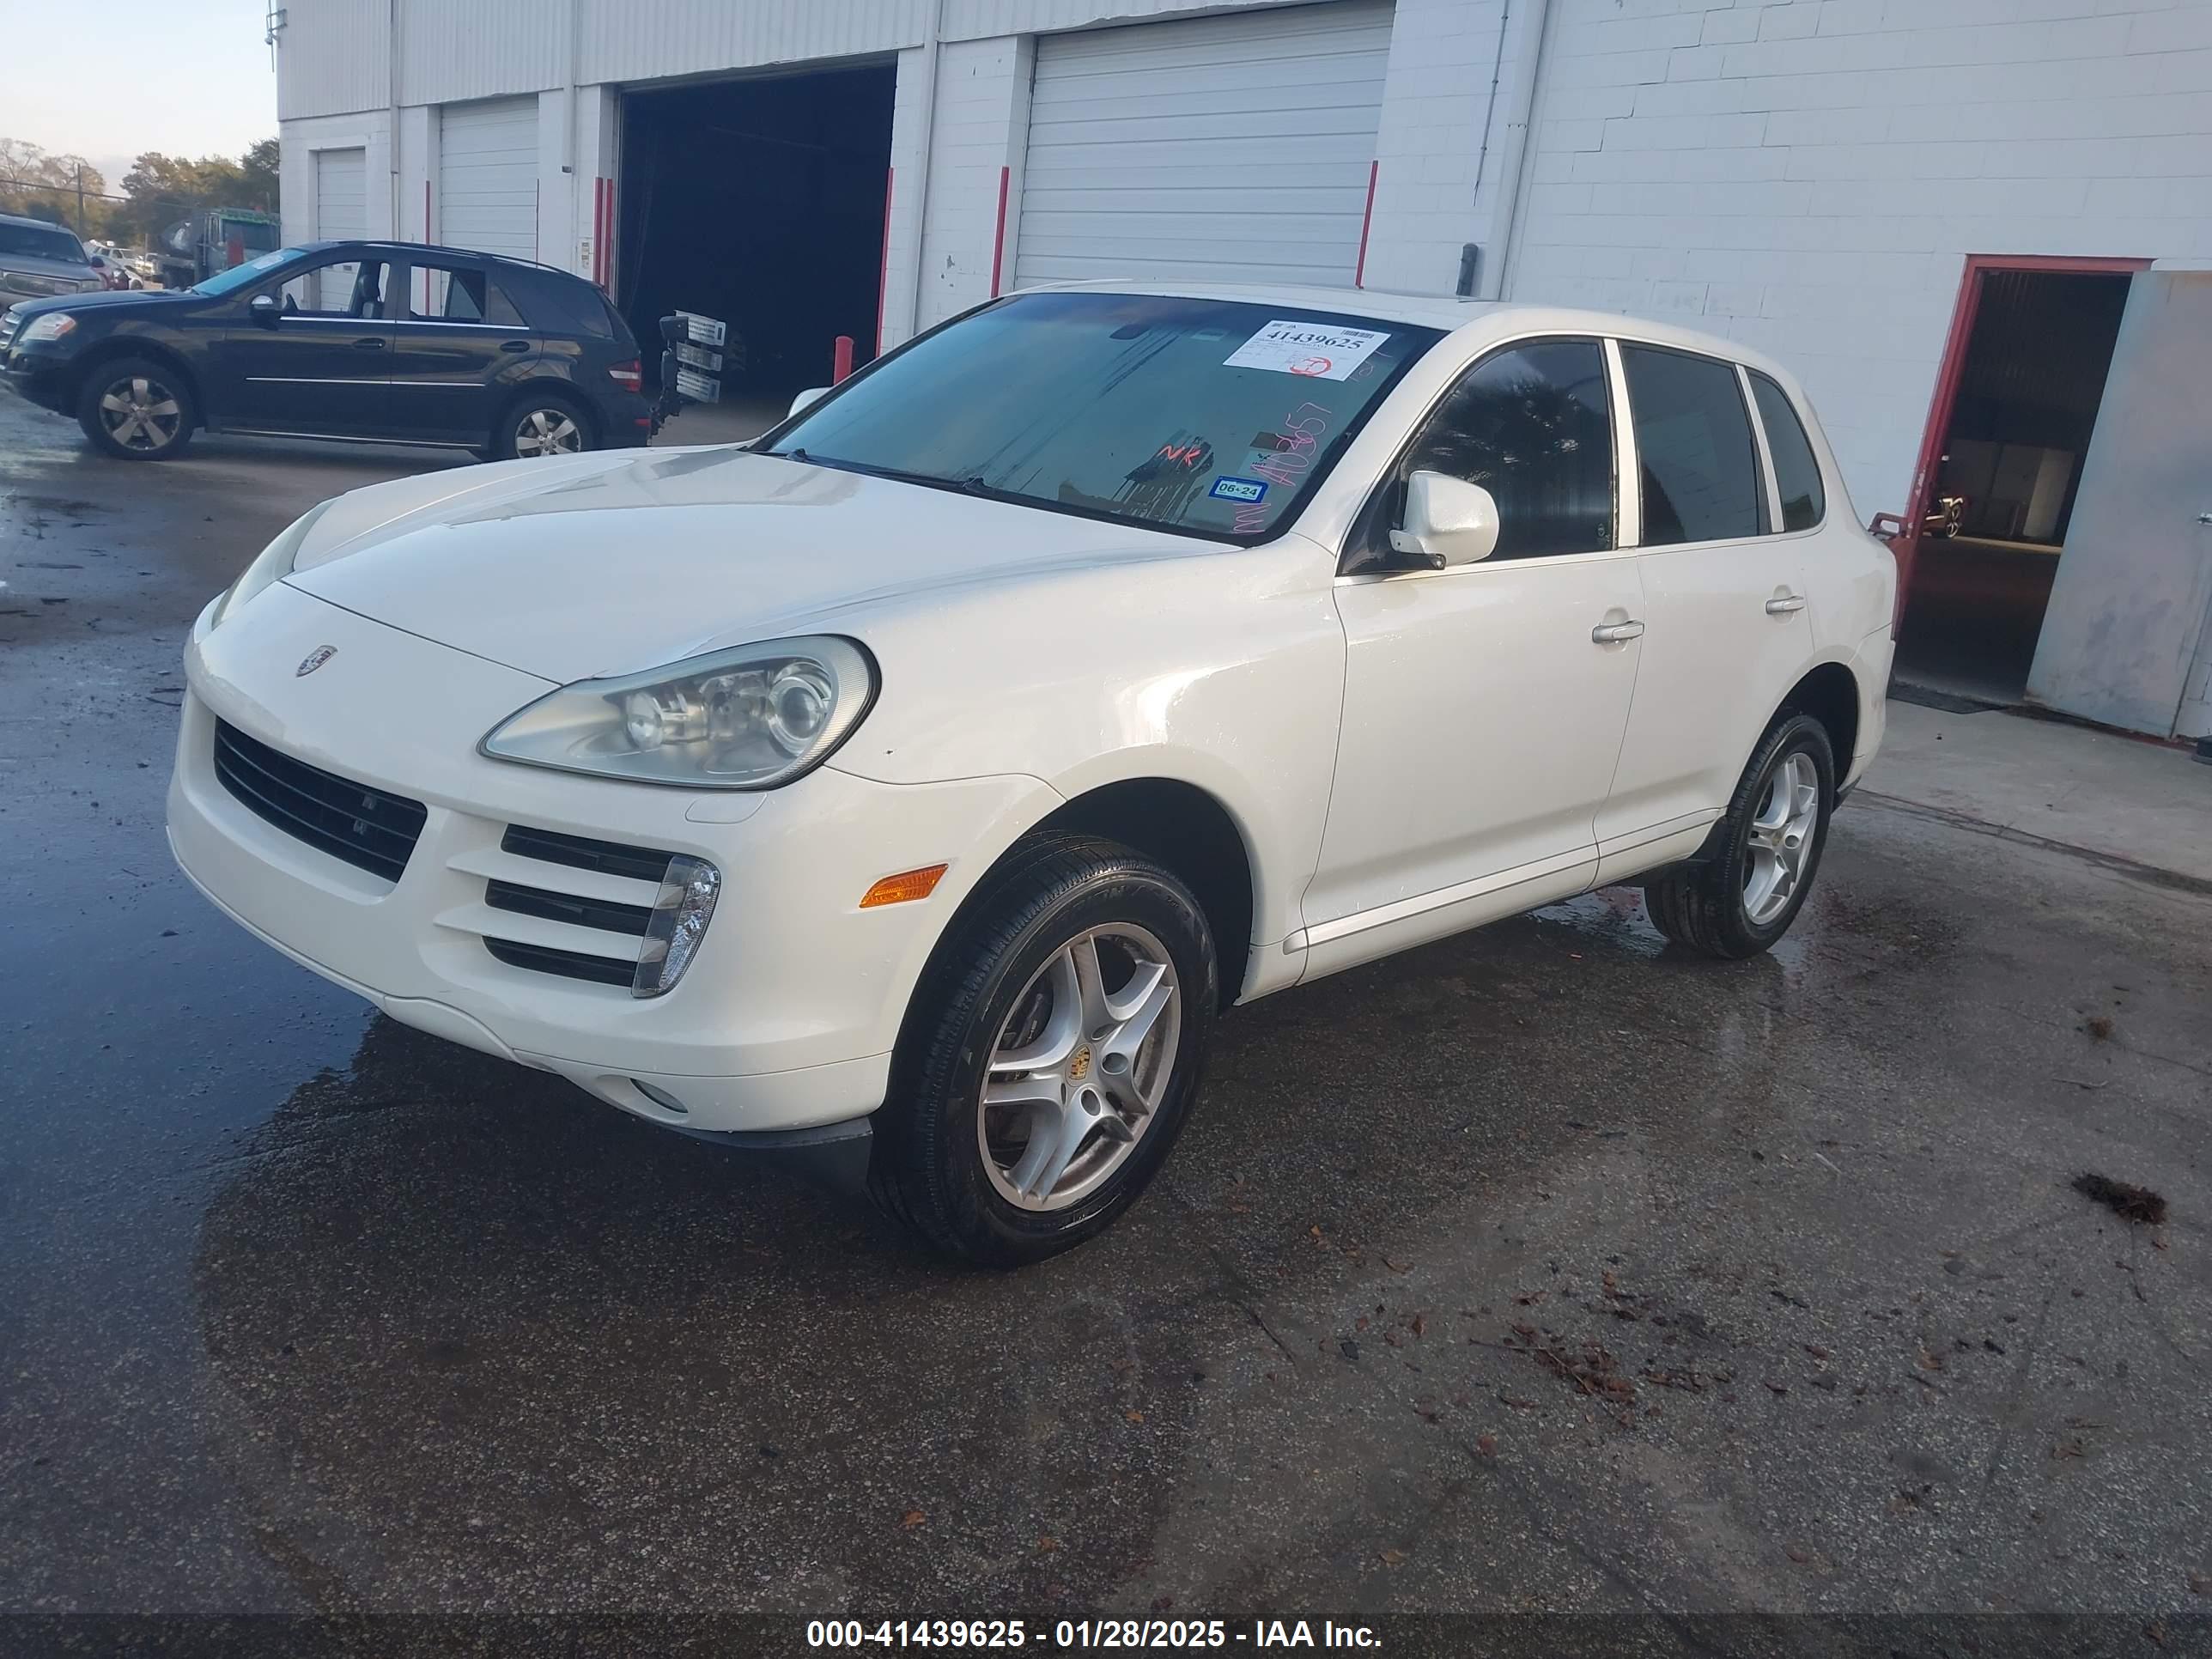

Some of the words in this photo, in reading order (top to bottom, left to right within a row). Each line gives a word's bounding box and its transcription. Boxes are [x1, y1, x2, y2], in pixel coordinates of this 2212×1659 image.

[1267, 330, 1365, 349] 41439625
[1218, 483, 1236, 492] 06
[1241, 487, 1258, 496] 24
